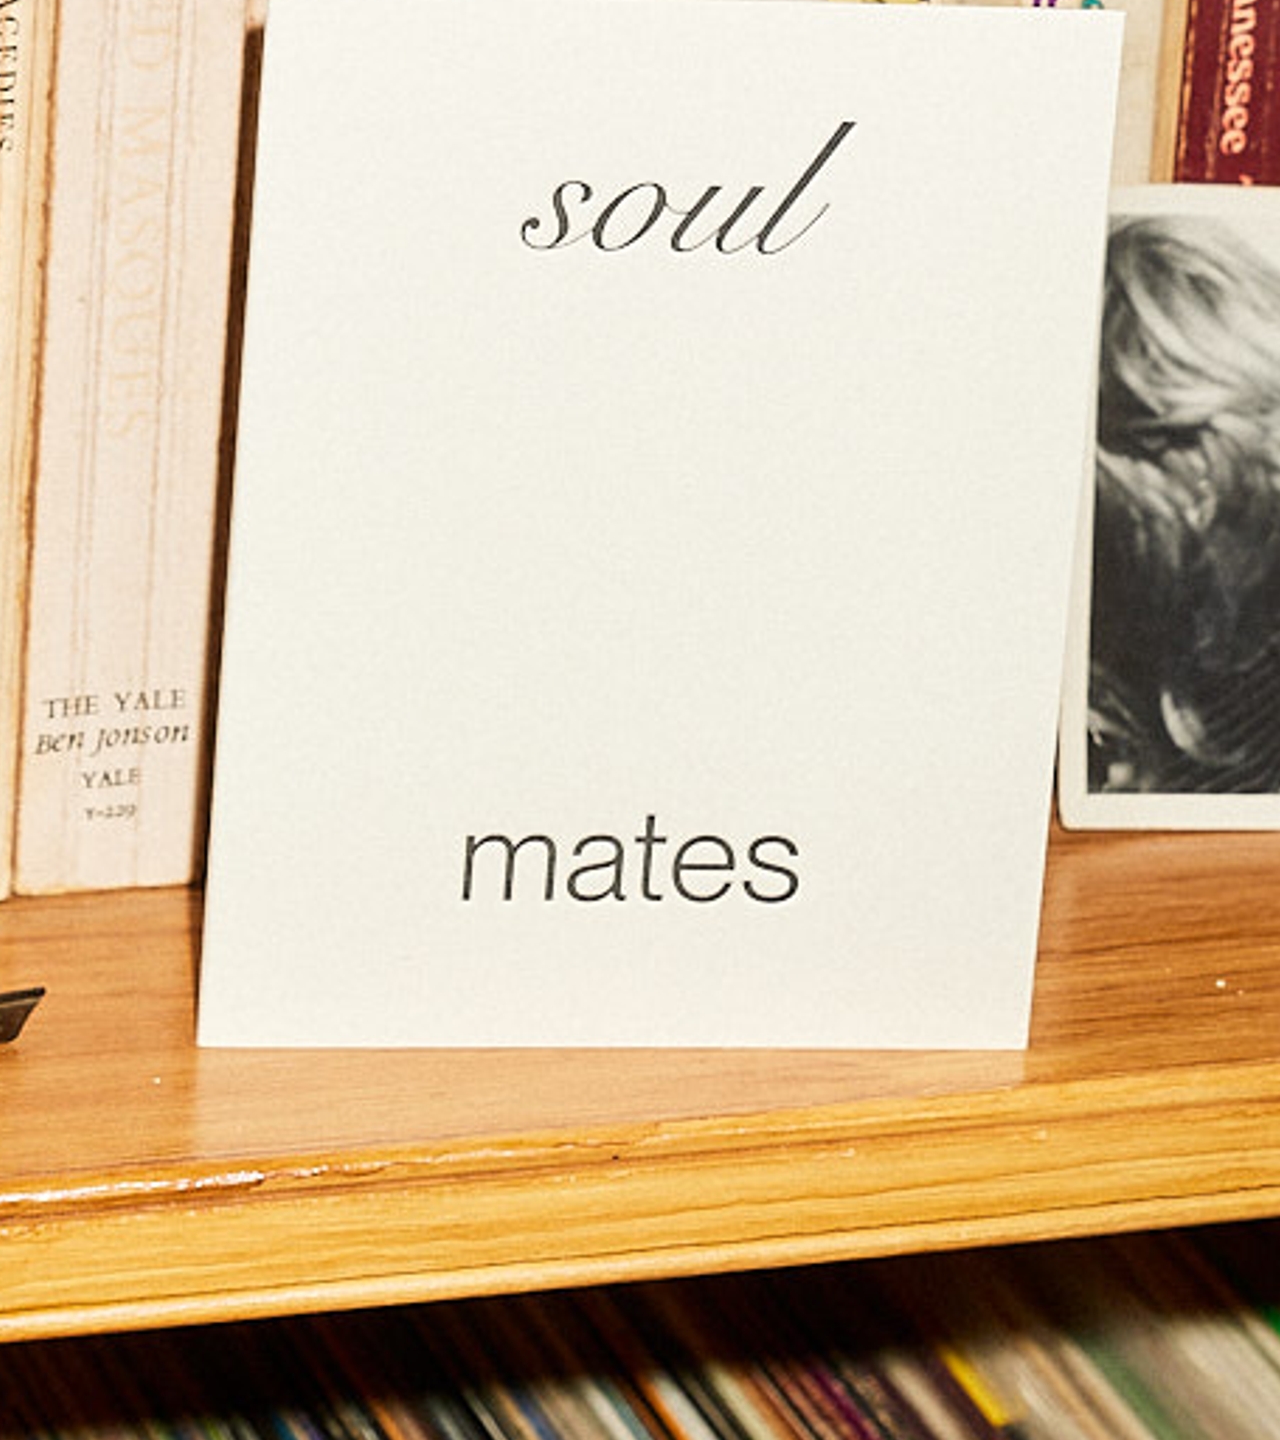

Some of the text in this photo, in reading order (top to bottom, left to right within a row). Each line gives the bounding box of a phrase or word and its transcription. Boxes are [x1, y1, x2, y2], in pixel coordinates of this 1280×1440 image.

[520, 121, 857, 255] soul
[45, 689, 186, 719] THE YALE
[35, 722, 190, 757] Ben Jonson
[83, 769, 140, 790] YALE
[463, 815, 799, 904] mates
